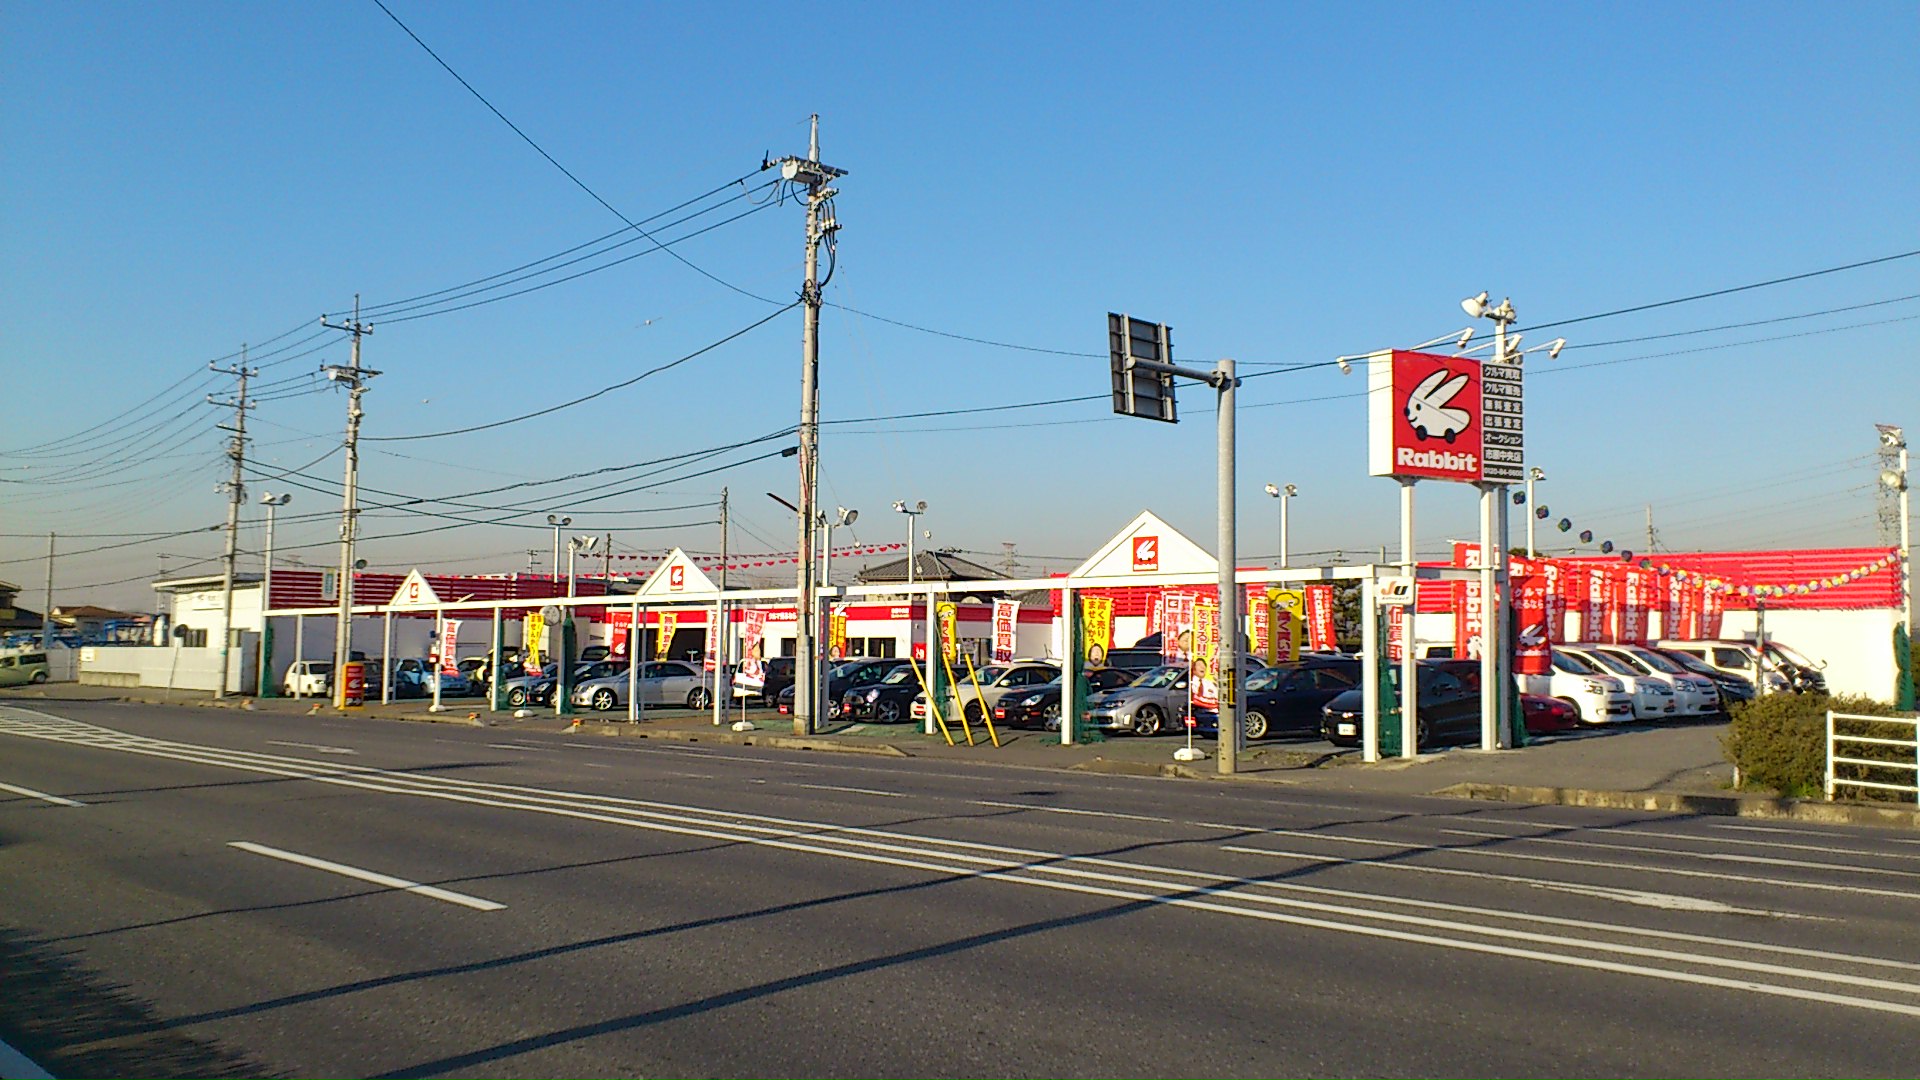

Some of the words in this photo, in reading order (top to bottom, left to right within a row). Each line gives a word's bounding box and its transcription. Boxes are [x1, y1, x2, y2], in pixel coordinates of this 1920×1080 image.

[1485, 433, 1522, 445] オークション
[1397, 447, 1478, 472] Rabbit
[1465, 549, 1481, 633] Rbbit
[996, 602, 1013, 663] 高価買取
[1097, 601, 1107, 639] 高く売り
